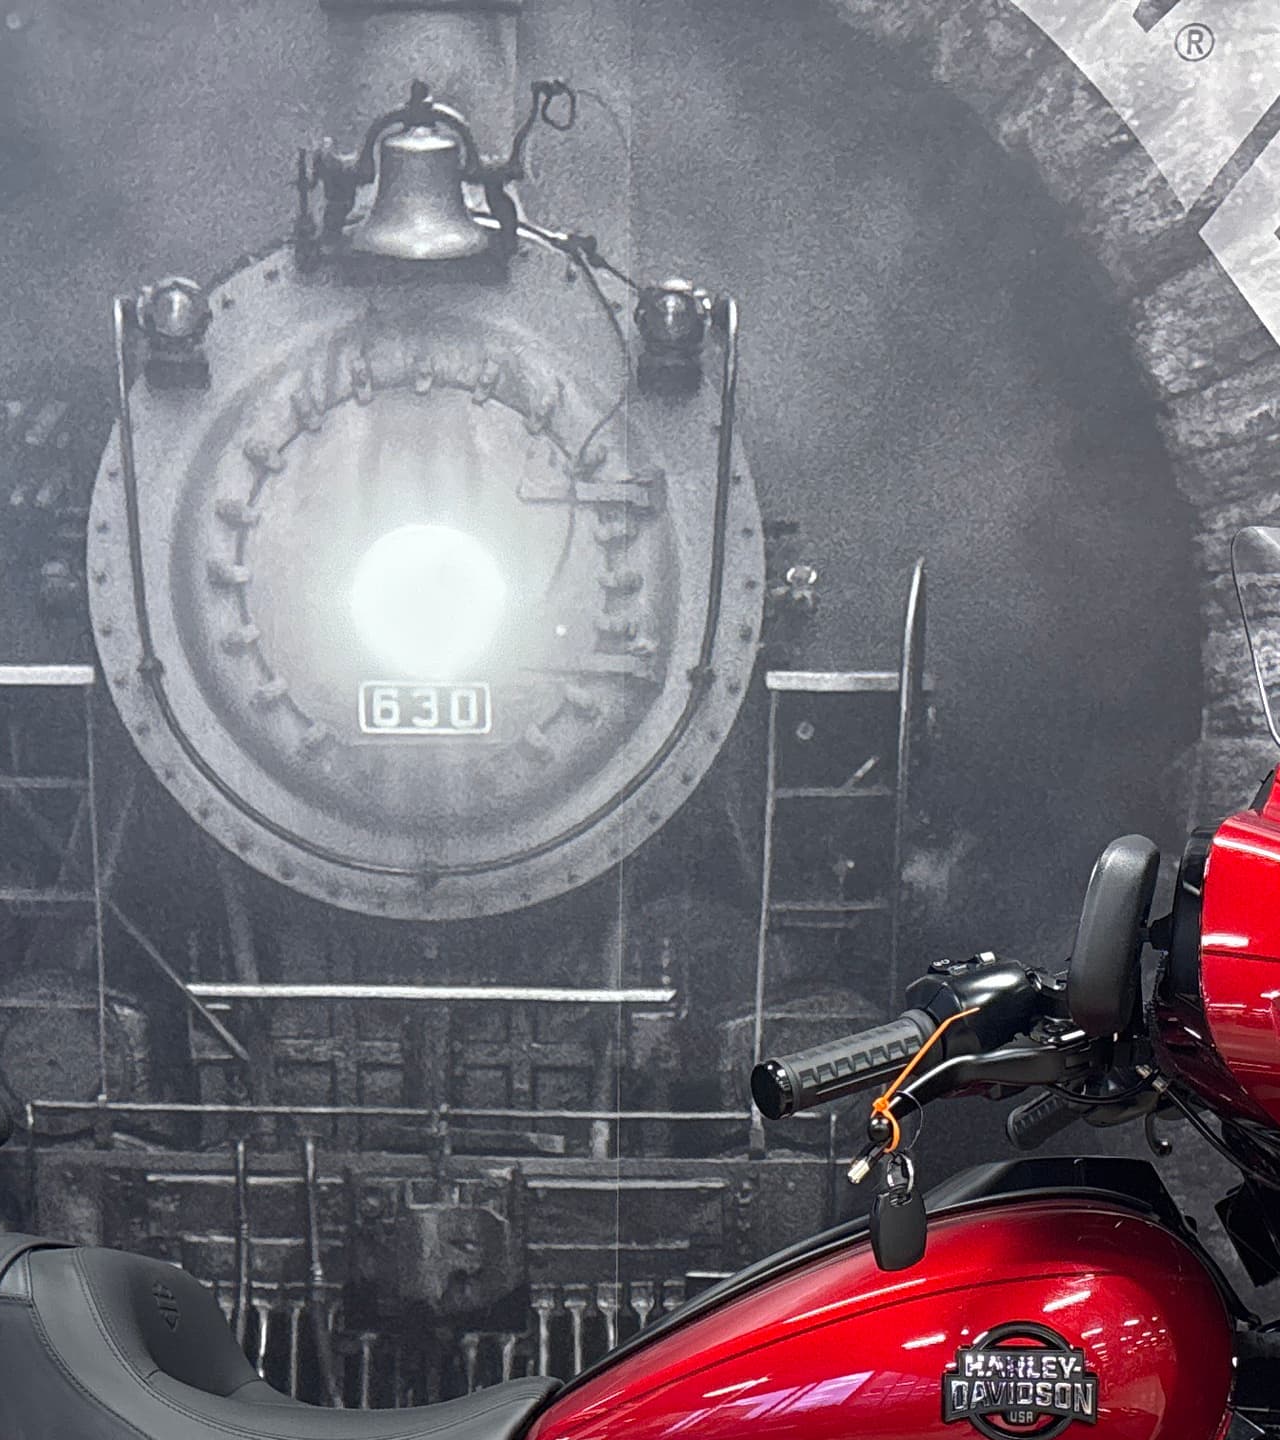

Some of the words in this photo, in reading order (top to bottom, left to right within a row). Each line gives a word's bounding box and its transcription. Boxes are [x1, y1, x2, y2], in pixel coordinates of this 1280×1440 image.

[372, 687, 479, 729] 630
[964, 1354, 1082, 1379] HARLEY-
[950, 1379, 1094, 1415] DAVIDSON
[1009, 1411, 1034, 1423] USA
